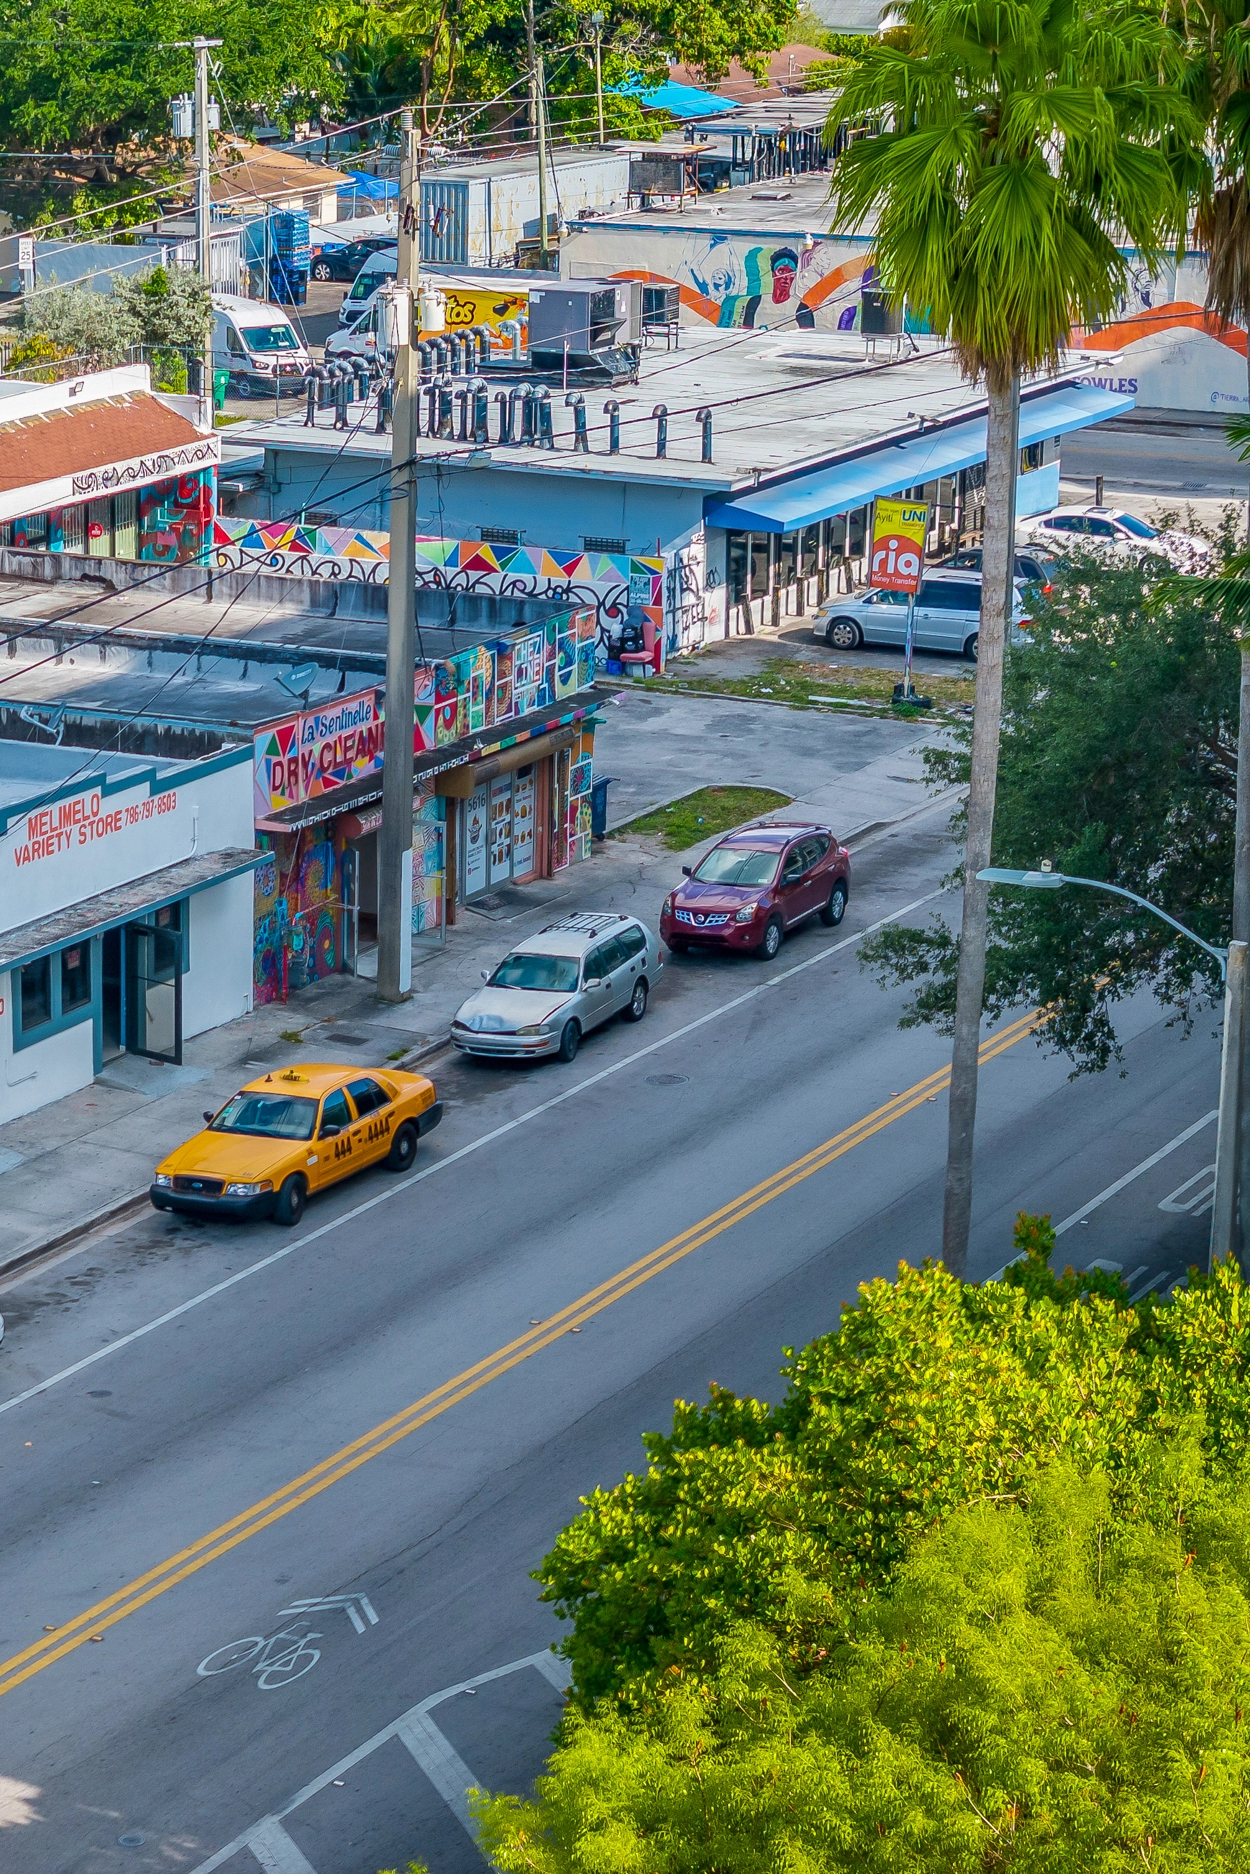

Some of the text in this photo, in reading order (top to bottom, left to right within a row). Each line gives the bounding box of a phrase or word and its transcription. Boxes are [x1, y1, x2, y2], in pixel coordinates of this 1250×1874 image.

[21, 252, 31, 260] 25
[445, 296, 475, 324] tos
[876, 512, 893, 523] Ayiti
[902, 509, 926, 522] UNI
[872, 539, 920, 576] ria
[872, 574, 918, 586] Money Transfer
[515, 637, 540, 664] CHEZ
[301, 700, 372, 745] La Sentinelle
[272, 748, 313, 792] DRY
[27, 793, 100, 841] MELIMELO
[467, 793, 486, 813] 5616
[14, 828, 73, 867] VARIETY
[78, 809, 123, 845] STORE
[334, 1116, 390, 1161] 444 4444
